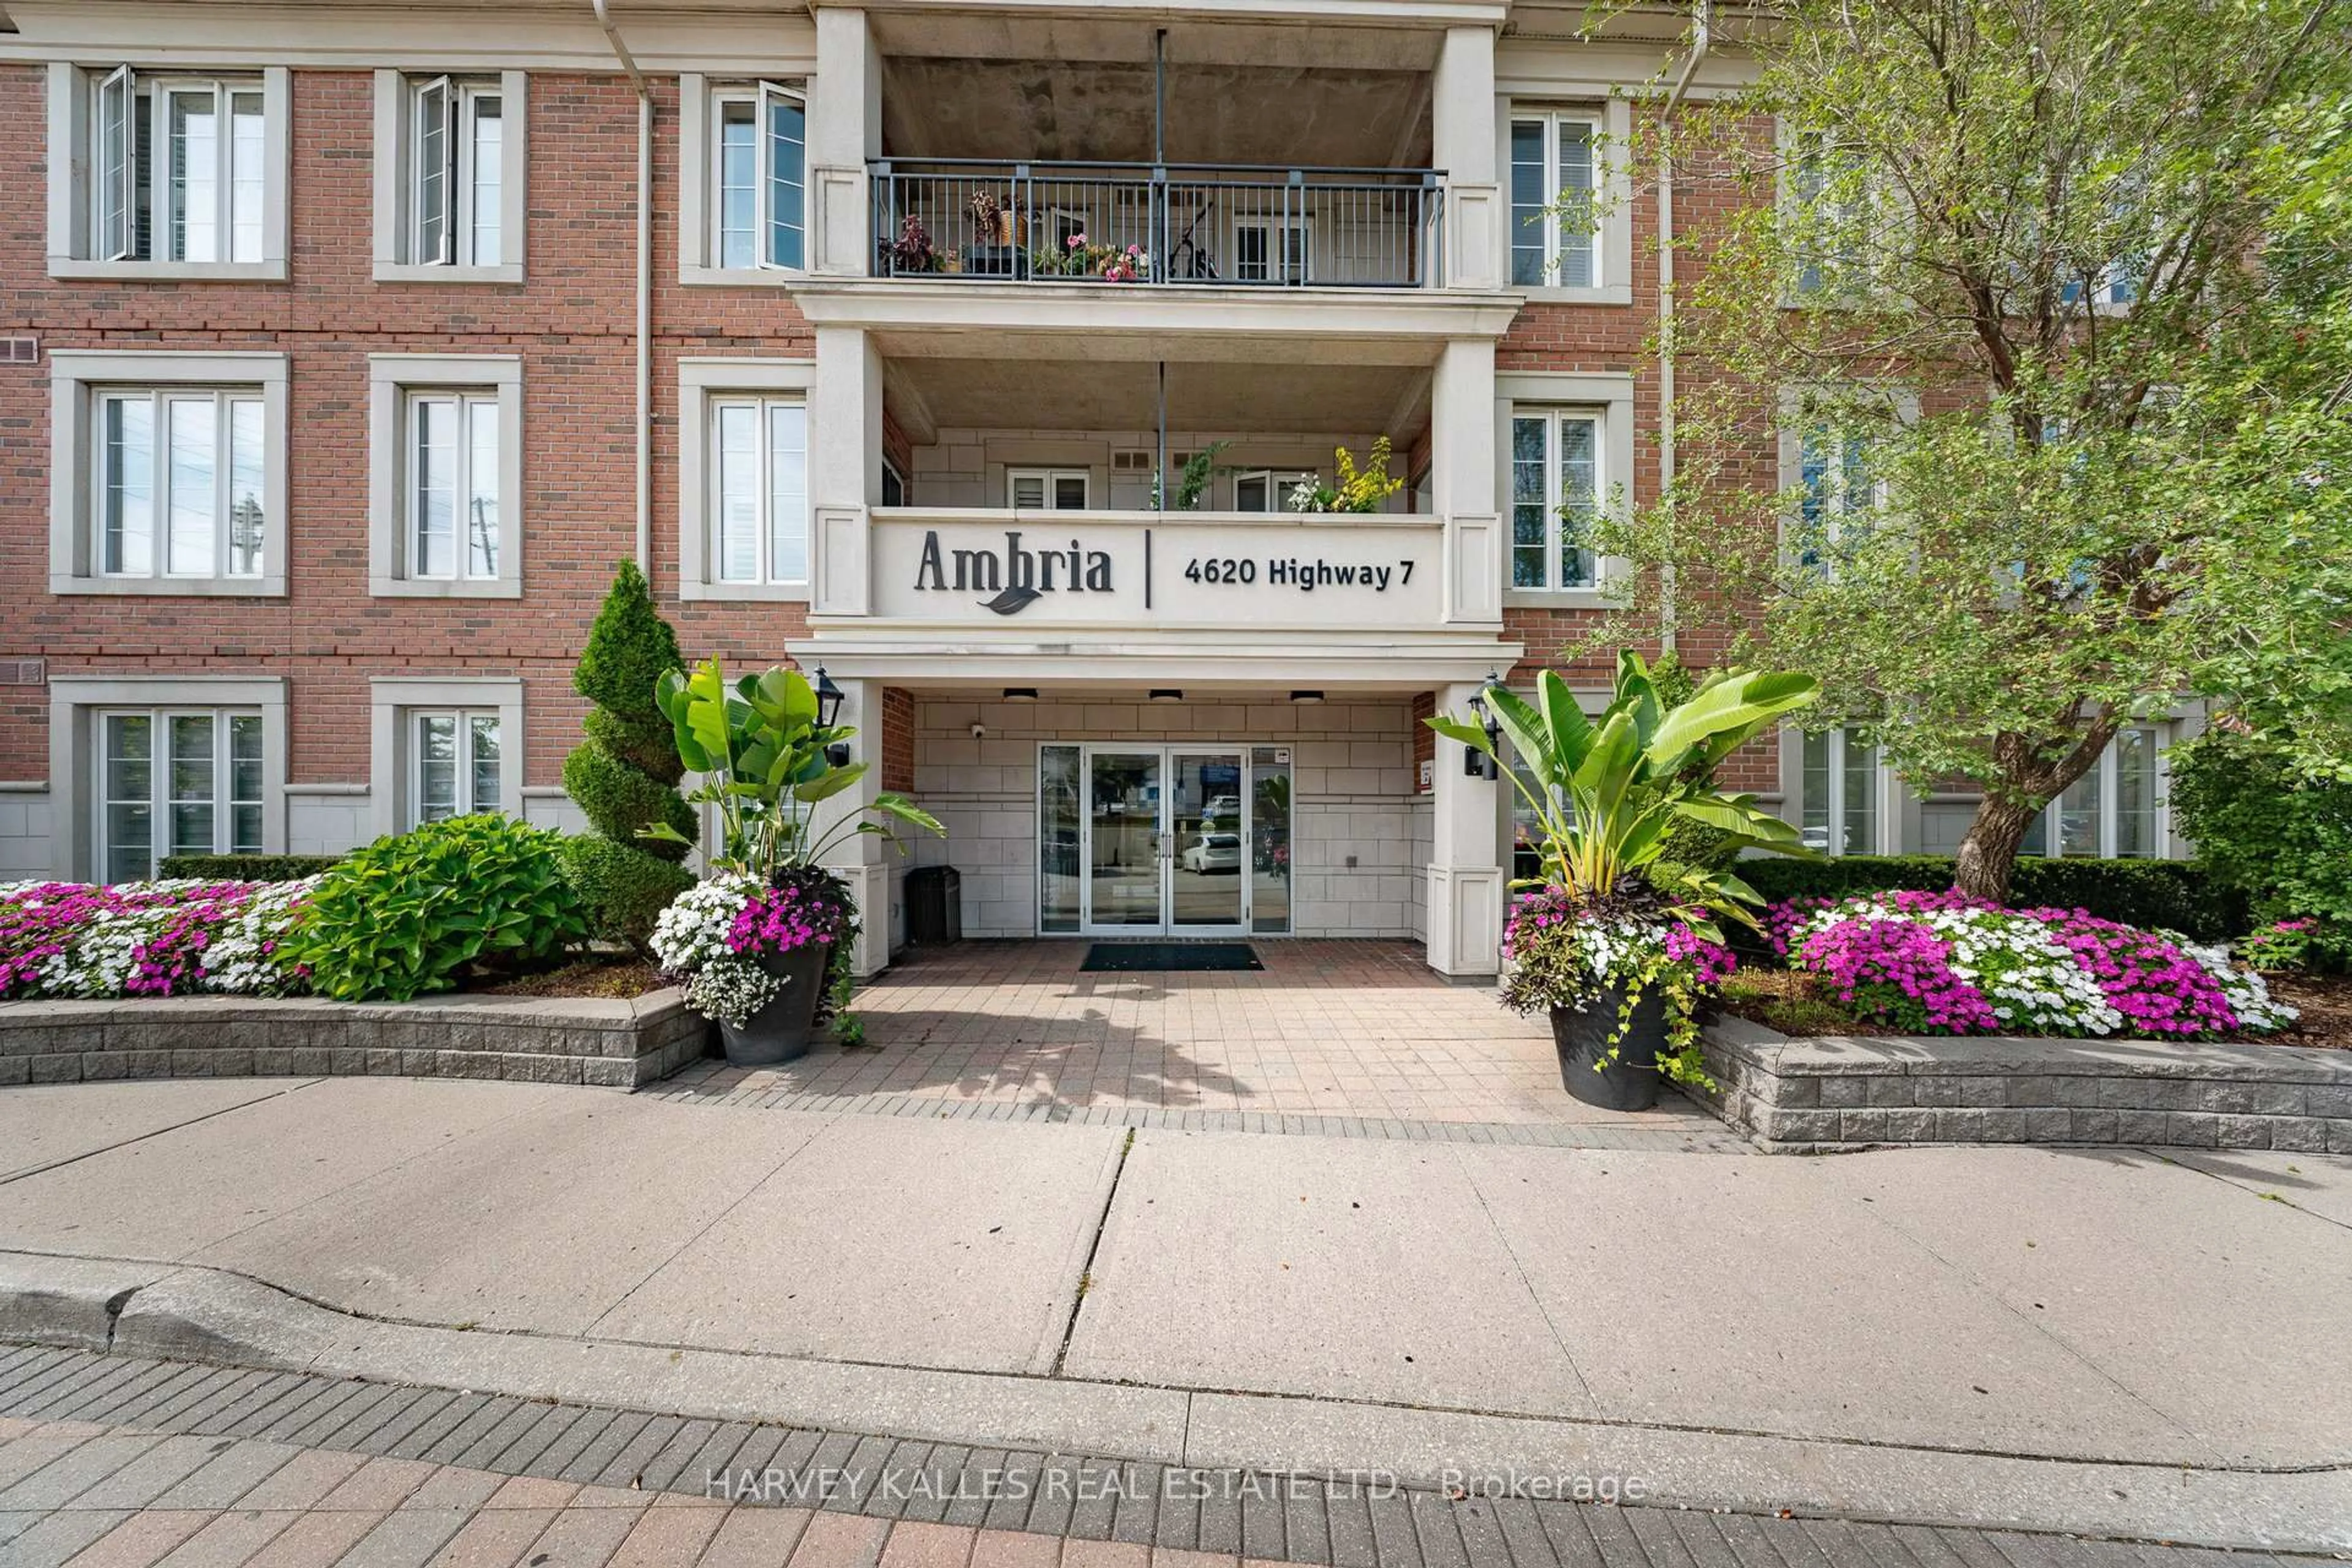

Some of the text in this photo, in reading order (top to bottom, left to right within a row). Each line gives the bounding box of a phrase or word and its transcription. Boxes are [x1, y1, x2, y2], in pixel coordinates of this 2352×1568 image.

[913, 530, 1114, 592] Ambria
[1184, 558, 1414, 592] 4620 Highway 7
